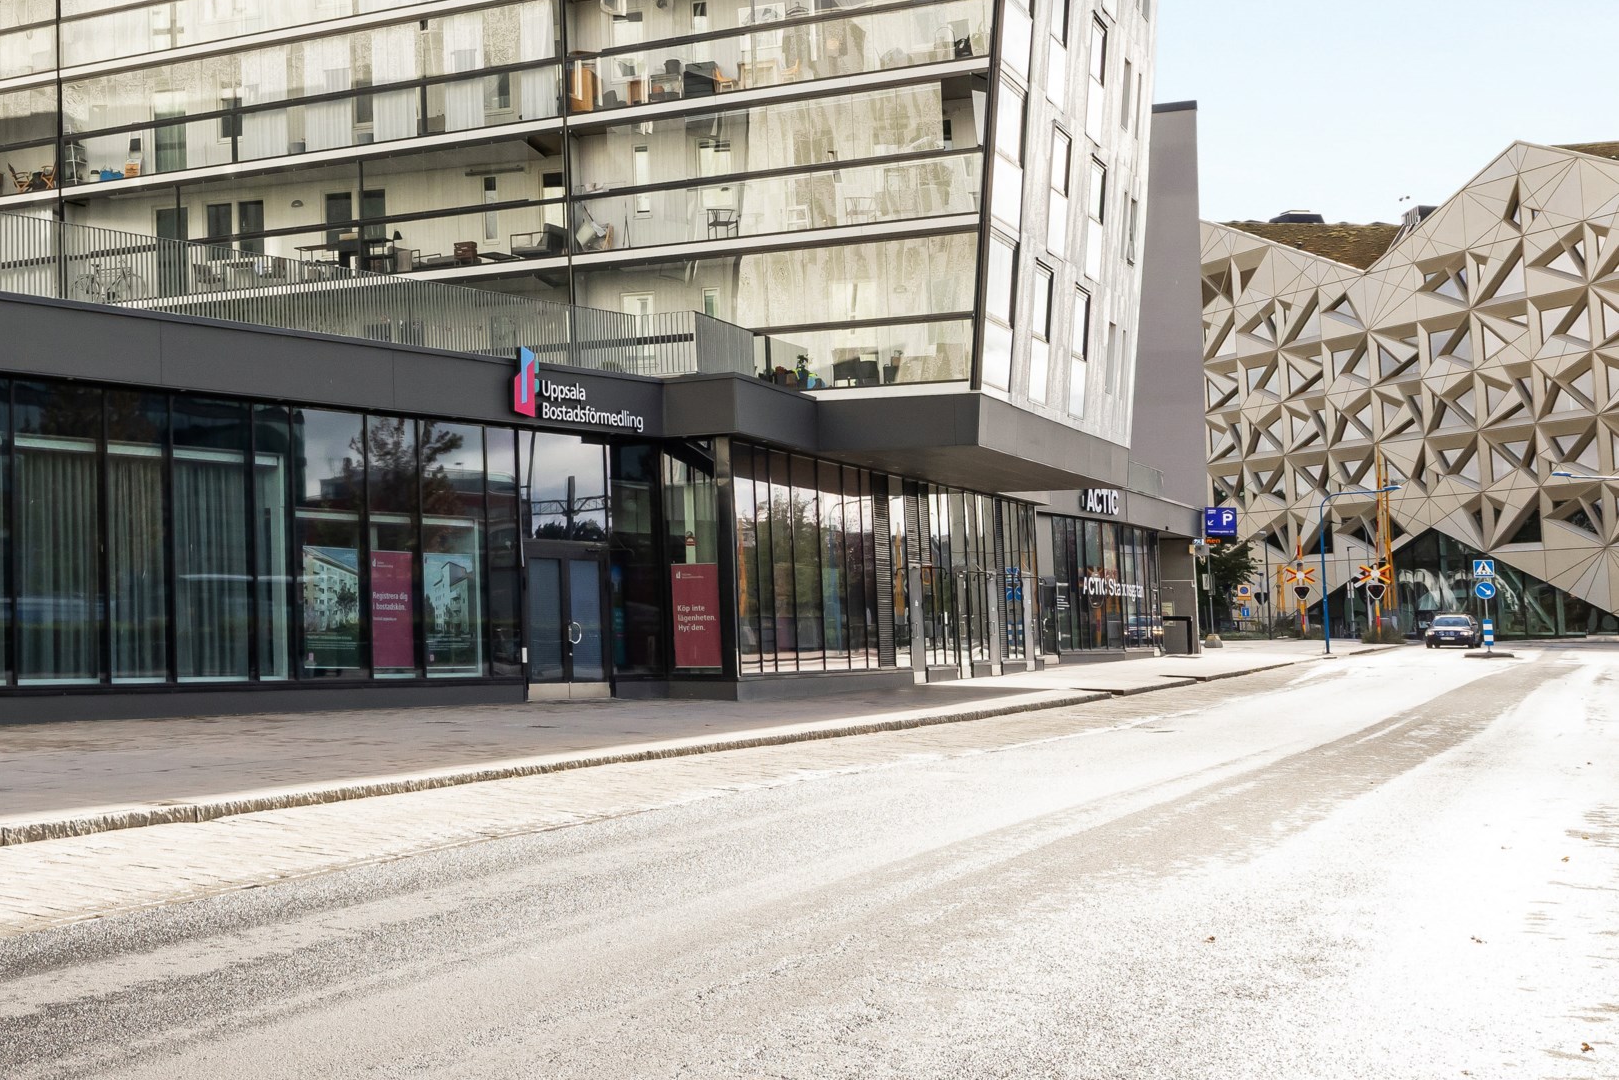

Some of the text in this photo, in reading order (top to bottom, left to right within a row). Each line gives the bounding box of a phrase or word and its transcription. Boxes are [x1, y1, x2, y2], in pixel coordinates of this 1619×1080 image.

[542, 380, 586, 402] Uppsala
[542, 402, 644, 433] Bostadsförmedling
[1086, 488, 1119, 515] ACTIC
[1083, 576, 1108, 596] ACTIC
[677, 604, 705, 612] Köp inte
